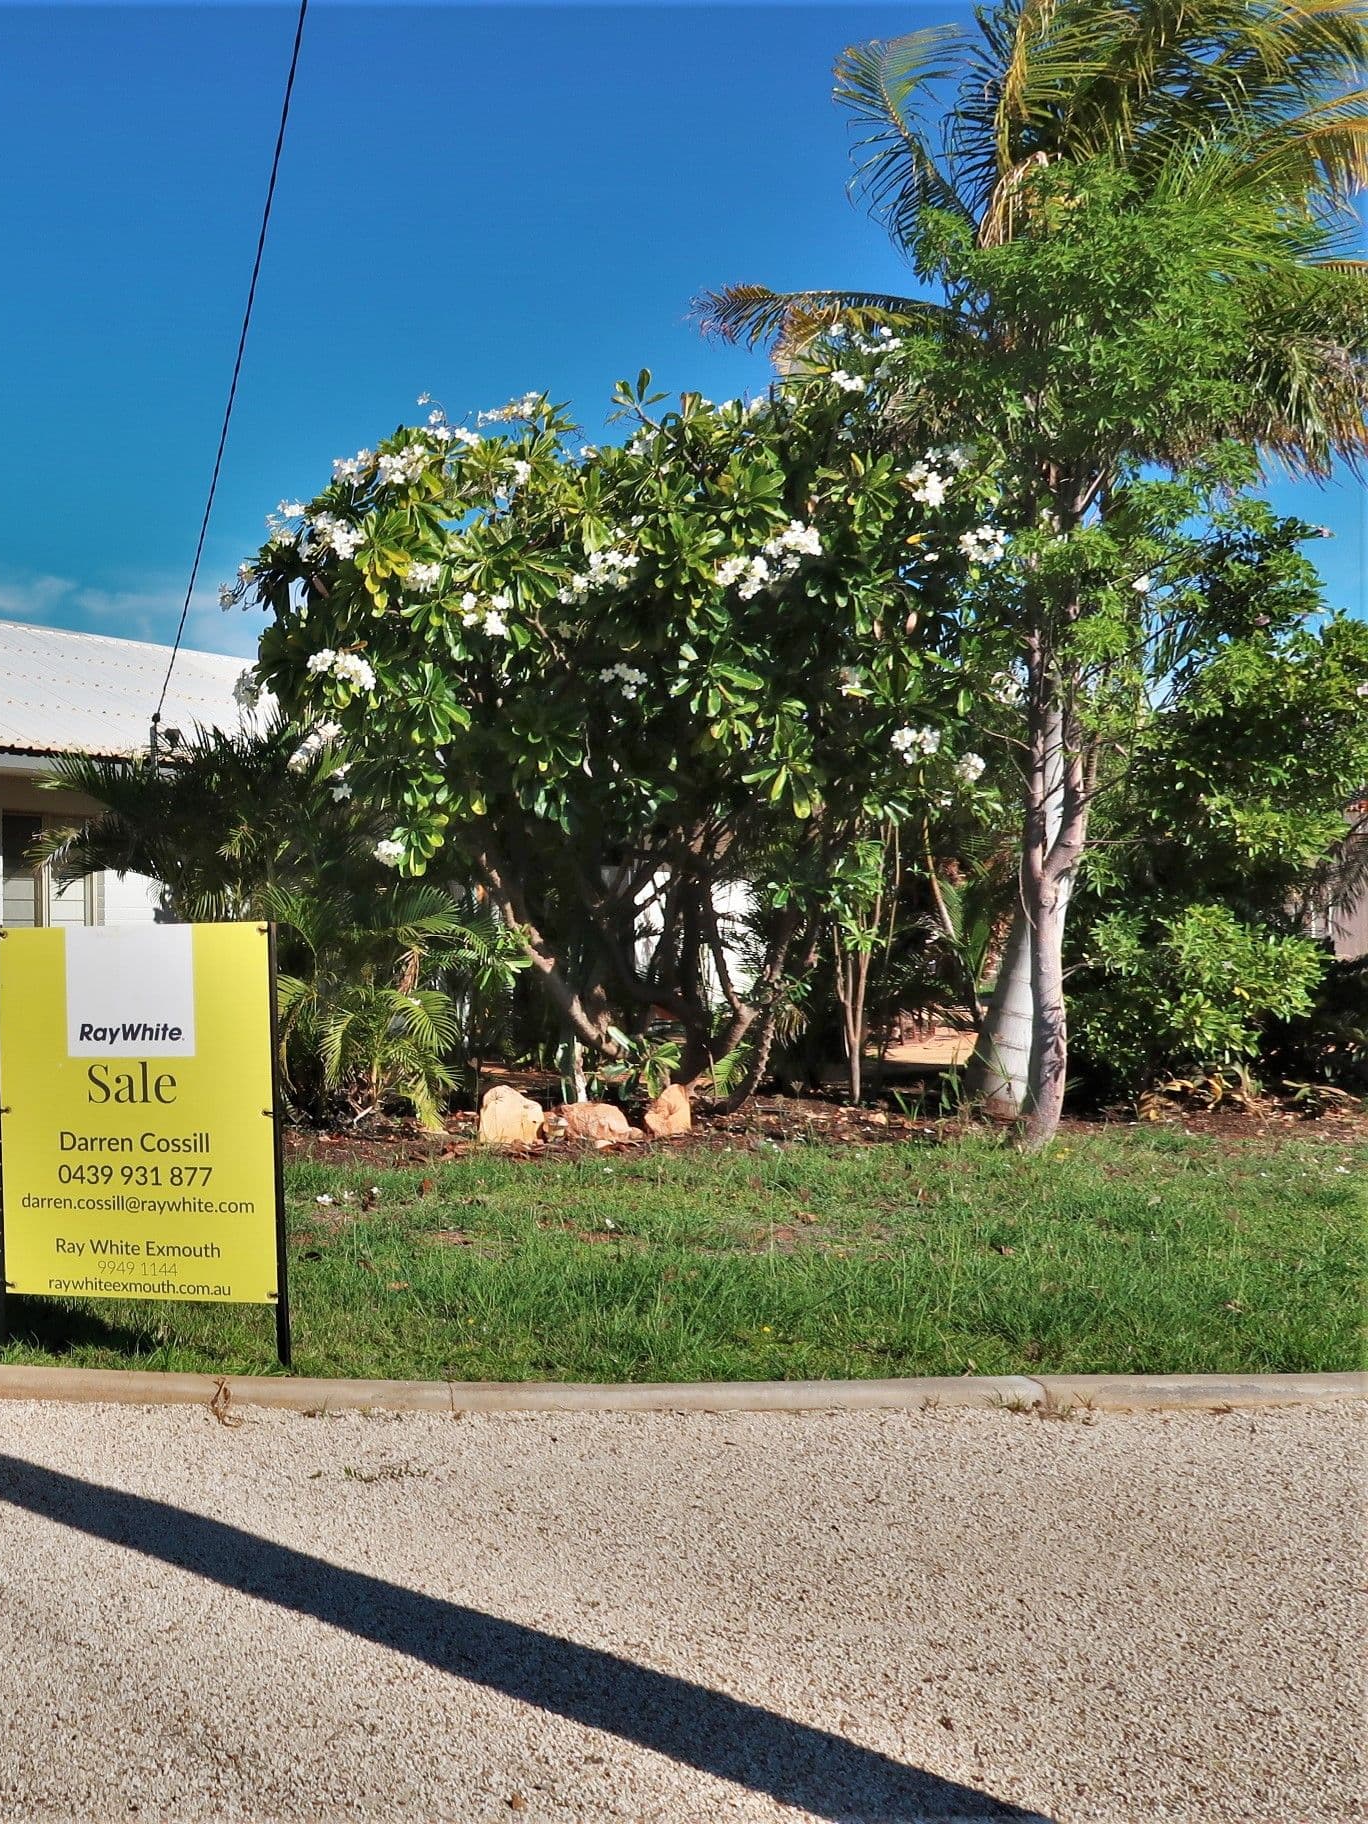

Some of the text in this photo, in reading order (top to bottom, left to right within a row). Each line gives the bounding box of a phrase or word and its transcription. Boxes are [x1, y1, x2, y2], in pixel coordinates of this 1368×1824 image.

[87, 1061, 178, 1104] Sale
[59, 1131, 210, 1153] Darren Cossill
[58, 1164, 213, 1187] 0439 931 877
[21, 1193, 255, 1215] darren.cossill@raywhite.com
[55, 1238, 221, 1258] Ray White Exmouth
[97, 1260, 178, 1277] 9949 1144
[48, 1277, 231, 1296] raywhiteexmouth.com.au
